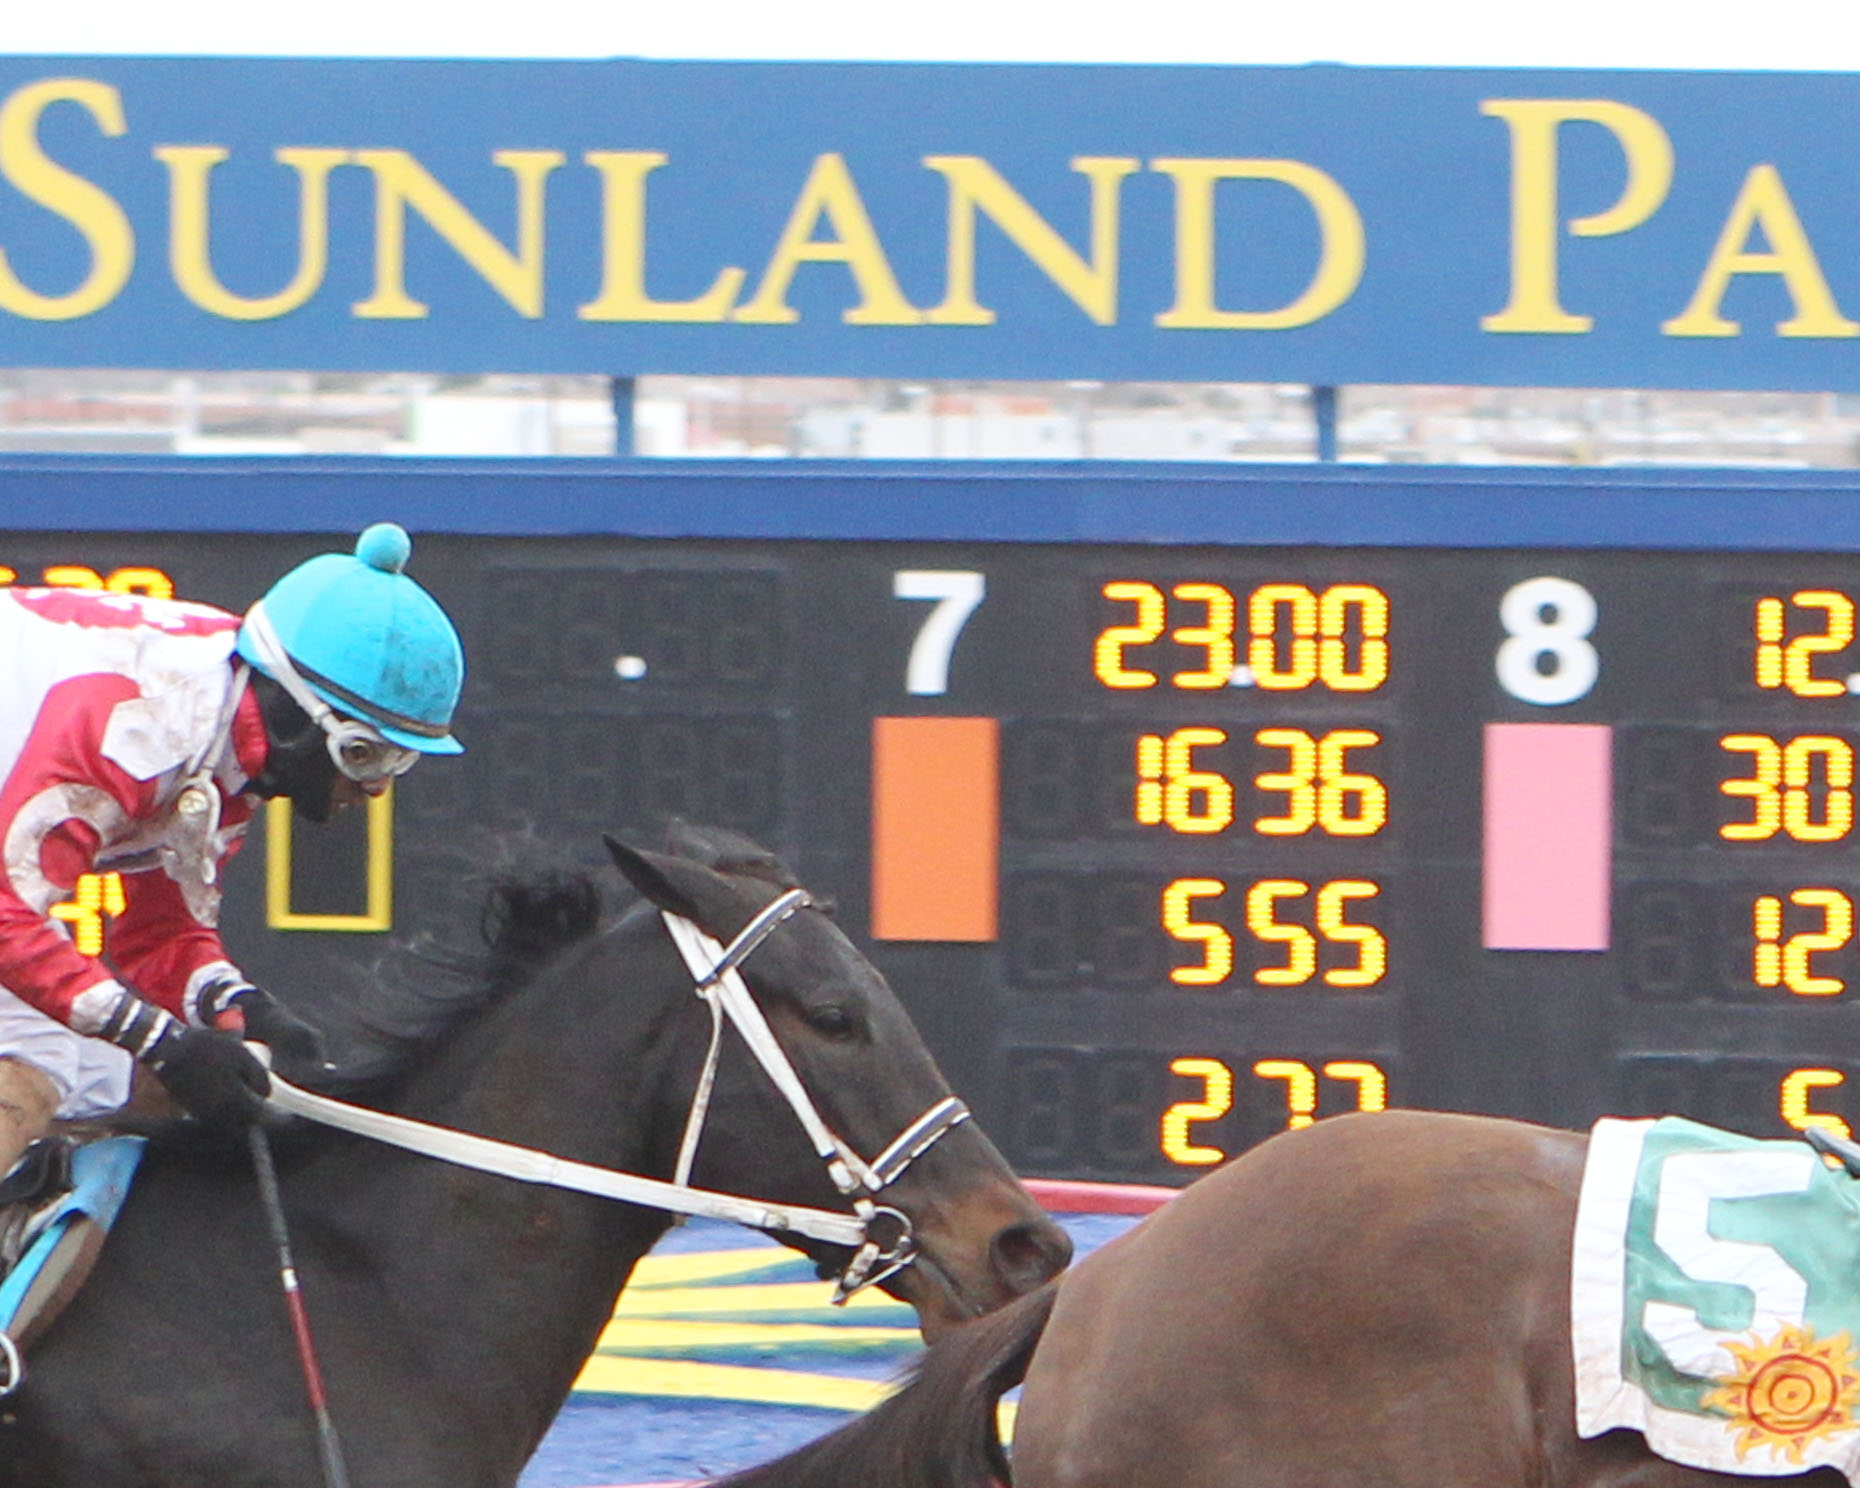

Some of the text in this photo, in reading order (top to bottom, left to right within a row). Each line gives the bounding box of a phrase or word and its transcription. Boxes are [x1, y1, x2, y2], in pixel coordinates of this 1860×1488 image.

[0, 78, 1366, 330] SUNLAND
[893, 570, 986, 696] 7
[1094, 581, 1388, 692] 23.00
[1495, 577, 1600, 706] 8
[1641, 1150, 1818, 1379] 5
